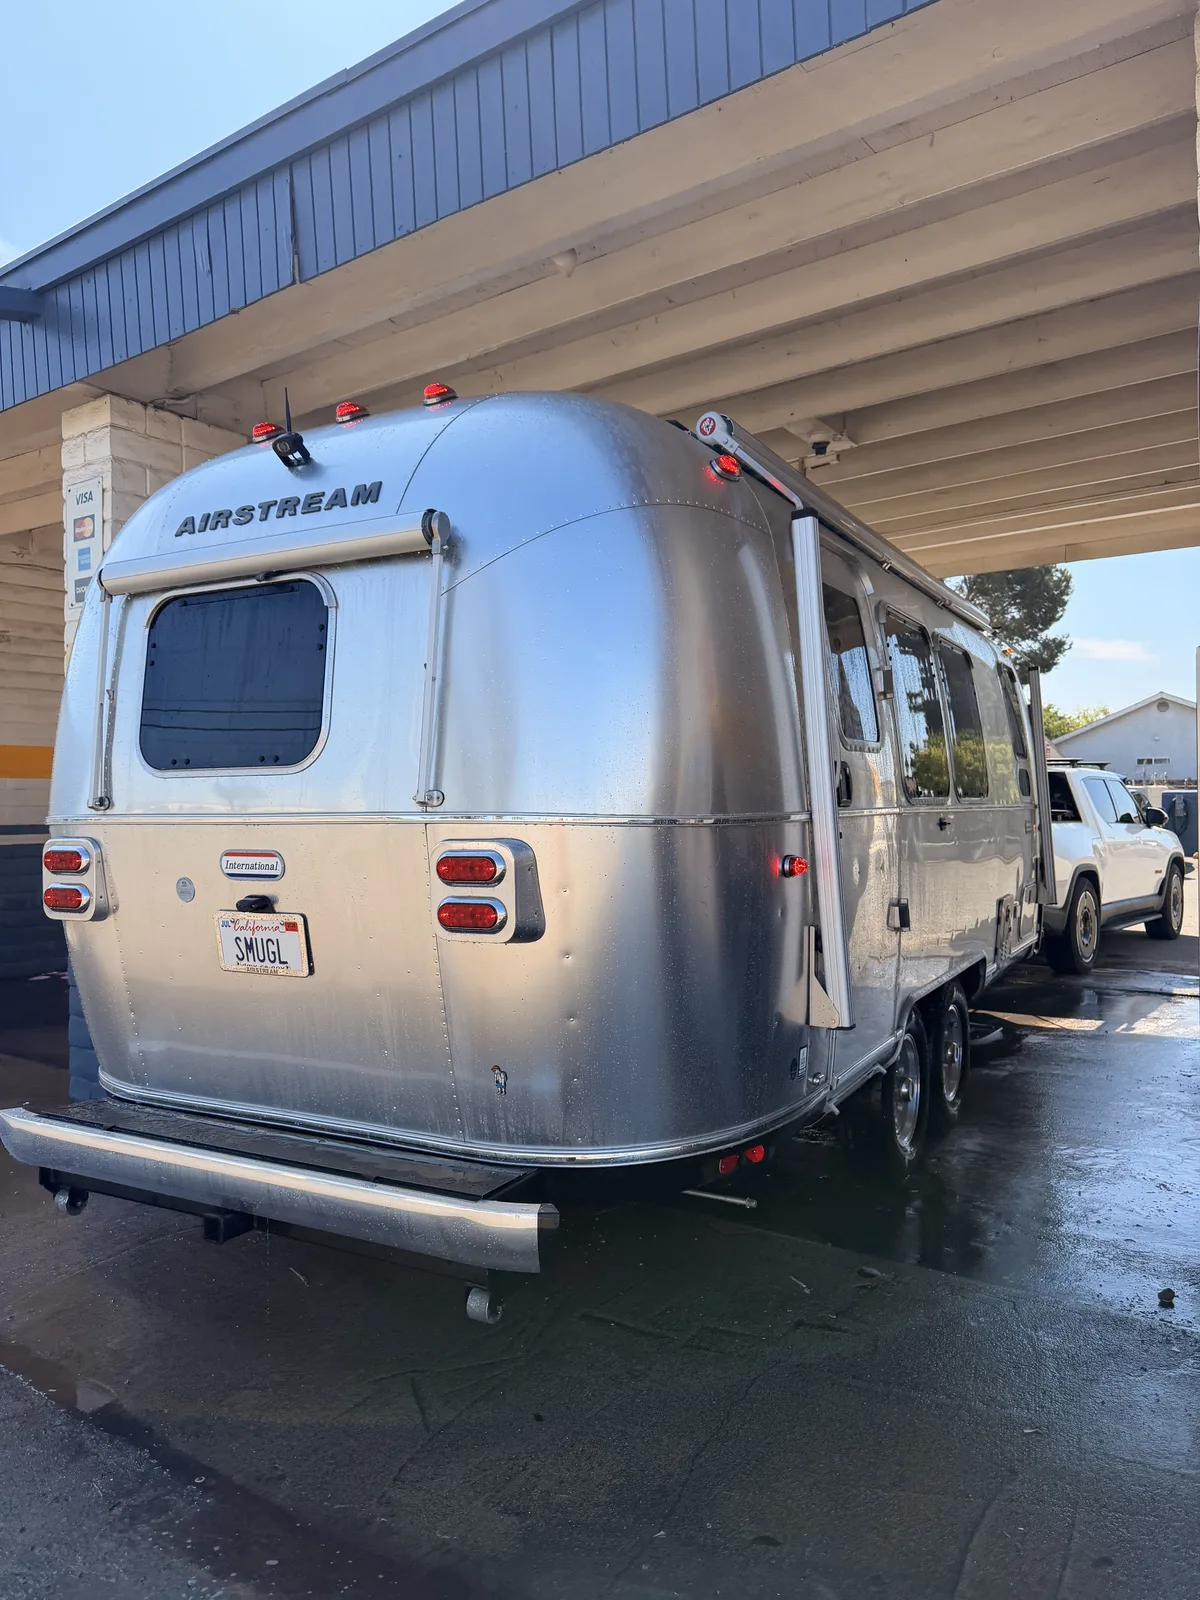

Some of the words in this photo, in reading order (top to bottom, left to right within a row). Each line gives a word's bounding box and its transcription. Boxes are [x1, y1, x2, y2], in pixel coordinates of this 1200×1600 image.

[75, 490, 94, 506] VISA
[174, 480, 383, 538] AIRSTREAM
[224, 859, 279, 871] International
[221, 920, 232, 928] JUL
[233, 918, 284, 936] California
[234, 936, 289, 965] SMUGL
